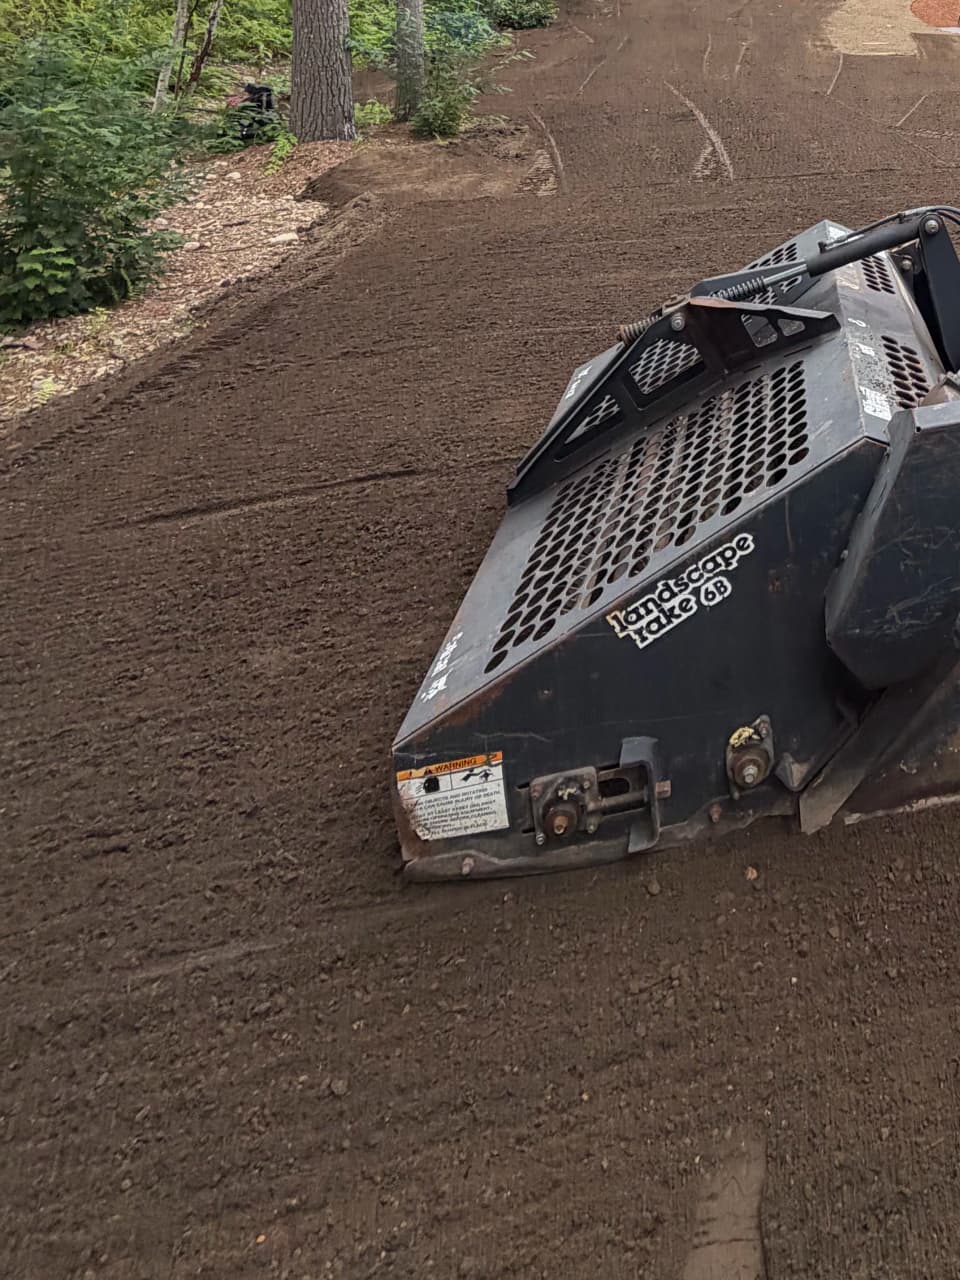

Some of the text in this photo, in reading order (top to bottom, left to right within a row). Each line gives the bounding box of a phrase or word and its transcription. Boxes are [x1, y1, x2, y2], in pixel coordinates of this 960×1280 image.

[610, 536, 751, 633] landscape
[633, 579, 729, 645] rake 6B
[435, 759, 477, 773] WARNING
